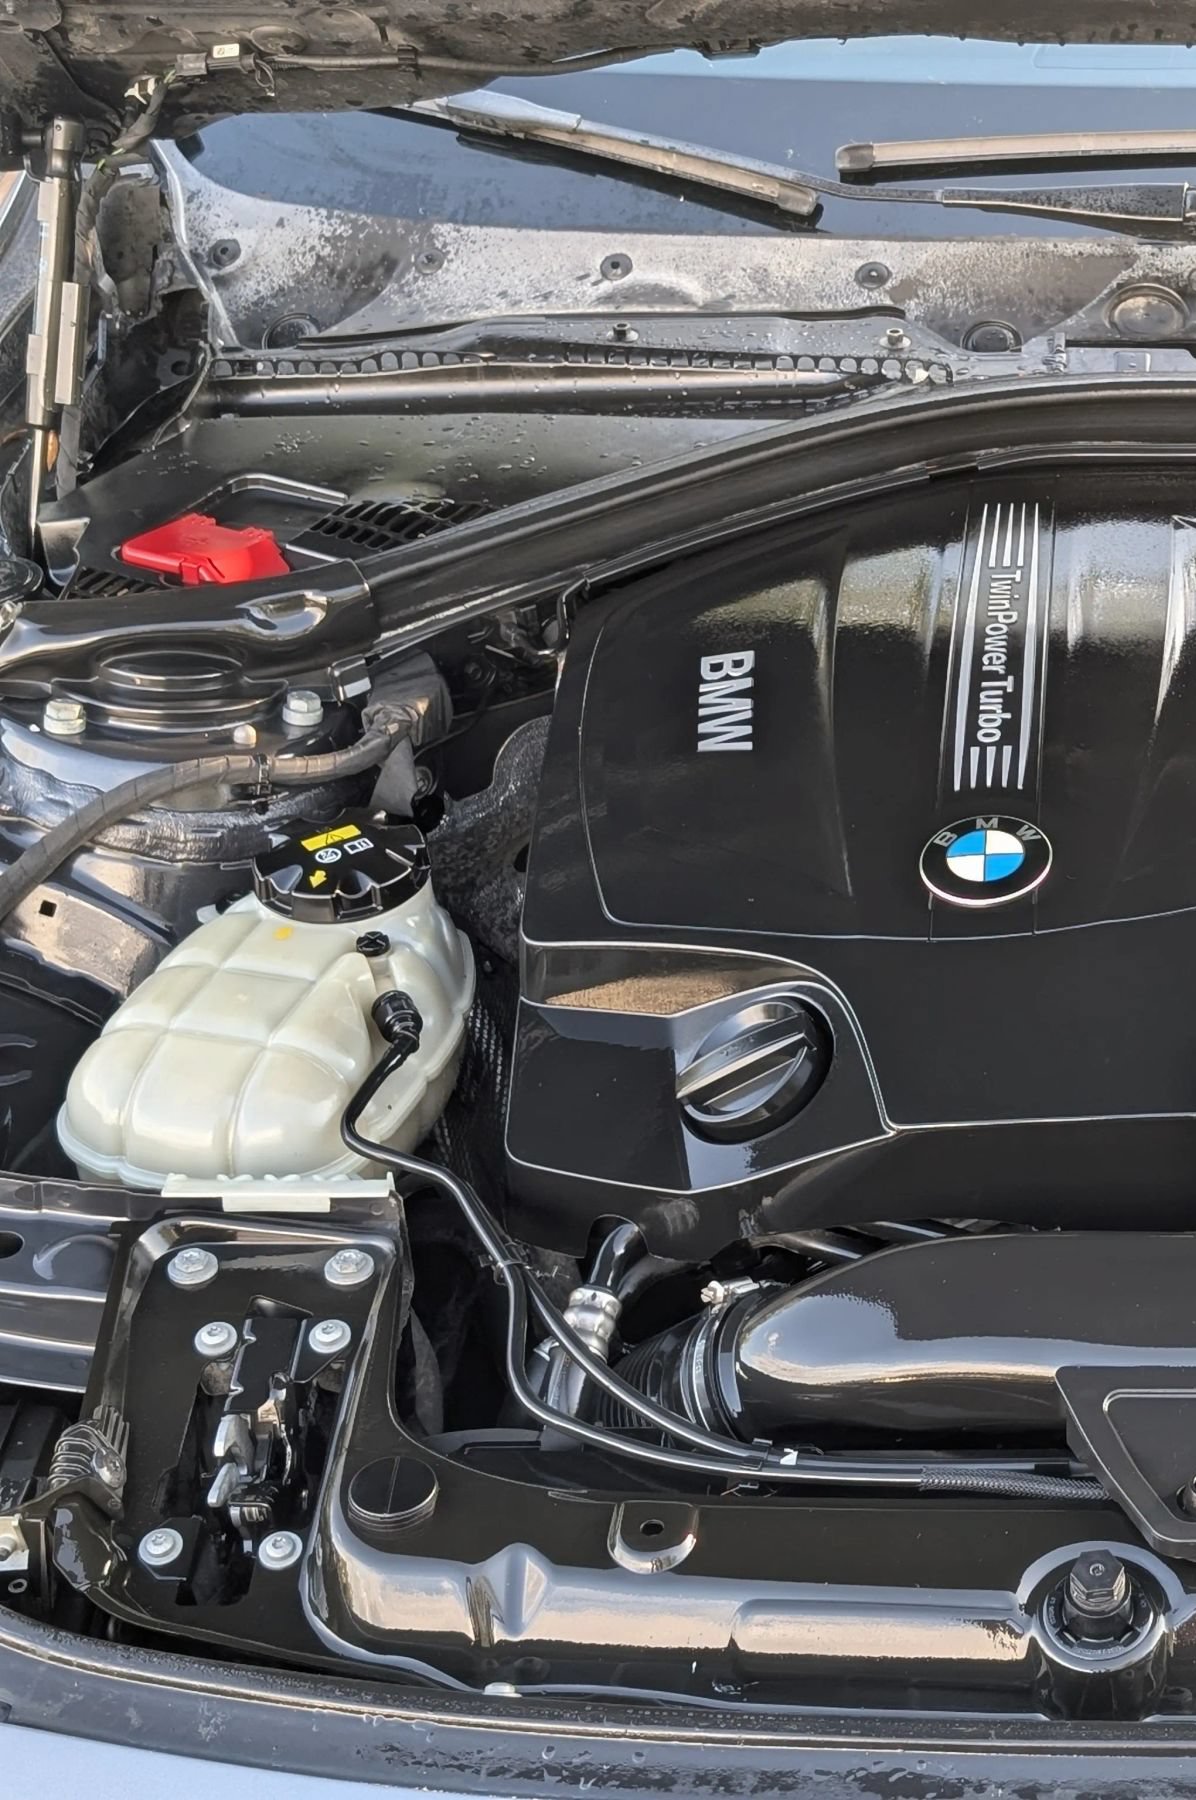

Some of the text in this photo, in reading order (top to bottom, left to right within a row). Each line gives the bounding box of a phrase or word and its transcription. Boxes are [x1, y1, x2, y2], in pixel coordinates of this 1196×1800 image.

[697, 649, 756, 753] BMW
[976, 569, 1023, 743] TwinPower Turbo
[933, 817, 1042, 848] BMW
